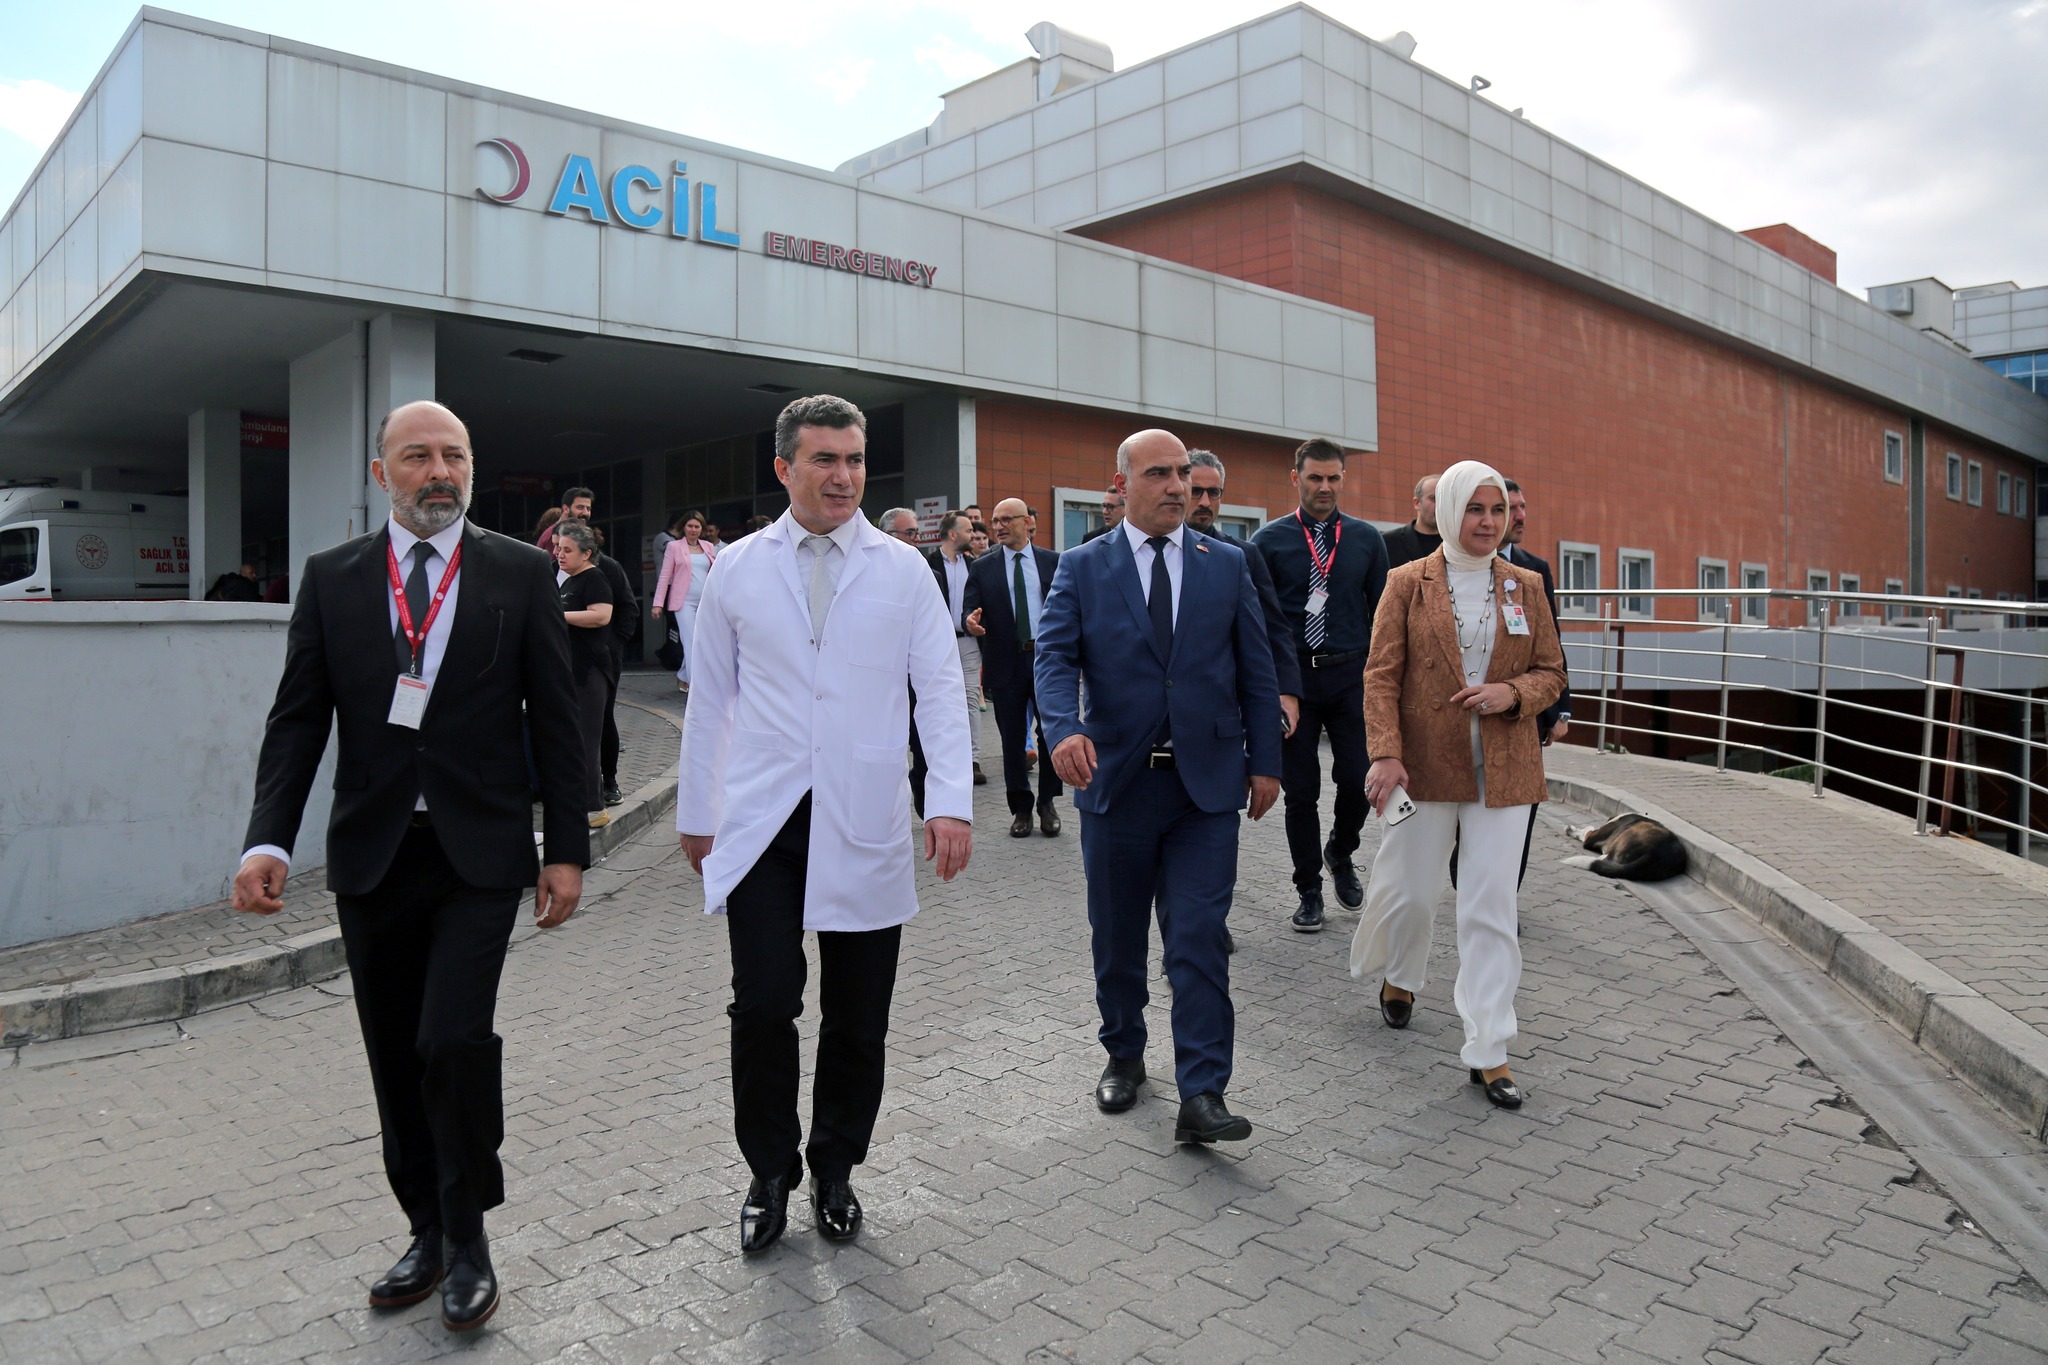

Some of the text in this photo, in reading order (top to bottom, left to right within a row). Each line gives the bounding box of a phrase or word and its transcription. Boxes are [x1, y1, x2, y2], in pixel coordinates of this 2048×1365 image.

[547, 152, 740, 249] ACİL
[766, 231, 938, 288] EMERGENCY
[172, 536, 188, 548] T.C.
[140, 546, 172, 560] SAĞLIK
[156, 560, 175, 574] ACİL
